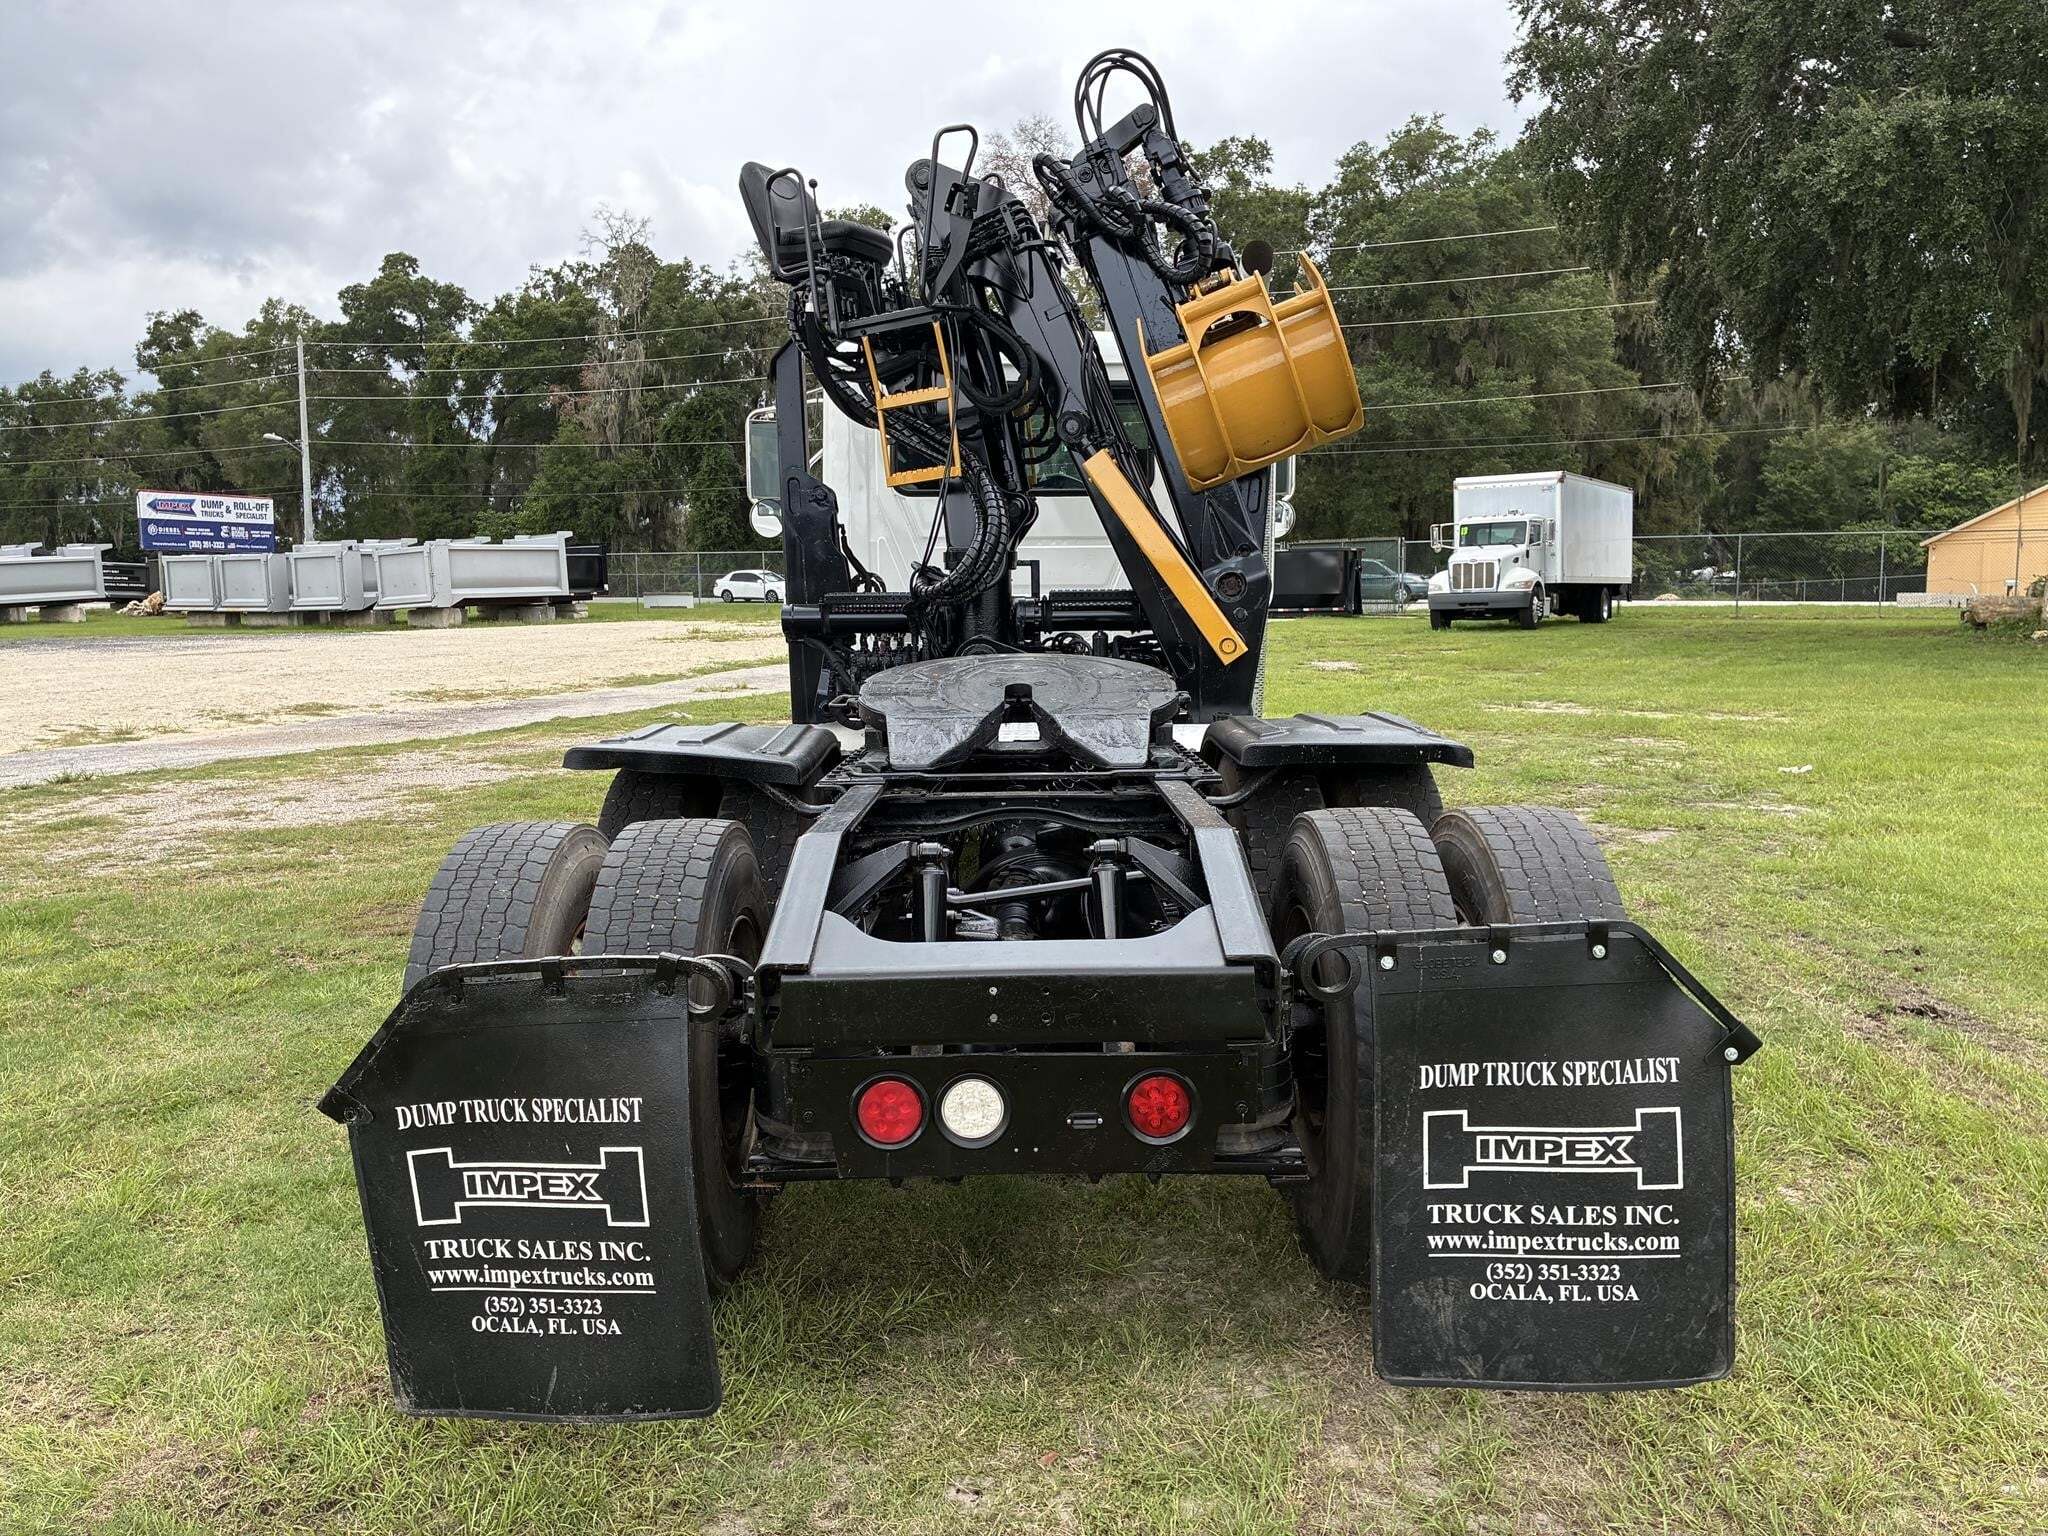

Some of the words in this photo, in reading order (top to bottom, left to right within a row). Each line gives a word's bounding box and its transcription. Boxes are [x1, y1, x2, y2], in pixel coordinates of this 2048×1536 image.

[201, 499, 224, 509] DUMP
[225, 505, 232, 514] &
[233, 501, 270, 512] ROLL-OFF
[201, 510, 224, 519] TRUCKS
[235, 512, 267, 520] SPECIALIST
[1419, 1063, 1479, 1089] DUMP
[1483, 1062, 1558, 1086] TRUCK
[1563, 1057, 1680, 1086] SPECIALIST
[395, 1102, 456, 1130] DUMP
[460, 1098, 529, 1123] TRUCK
[532, 1097, 642, 1123] SPECIALIST
[1476, 1135, 1635, 1164] IMPEX
[463, 1171, 603, 1200] IMPEX
[1427, 1204, 1524, 1224] TRUCK
[1531, 1205, 1617, 1225] SALES
[1624, 1205, 1679, 1225] INC.
[424, 1239, 513, 1259] TRUCK
[518, 1240, 593, 1260] SALES
[598, 1242, 650, 1261] INC.
[1427, 1230, 1680, 1253] www.impextrucks.com
[428, 1264, 654, 1288] www.impextrucks.com
[1487, 1263, 1533, 1283] (352)
[1538, 1264, 1620, 1280] 351-3323
[1470, 1283, 1553, 1304] OCALA,
[1558, 1285, 1591, 1301] FL.
[1597, 1285, 1640, 1301] USA
[485, 1296, 524, 1316] (352)
[529, 1298, 602, 1314] 351-3323
[472, 1316, 543, 1337] OCALA,
[548, 1318, 577, 1334] FL.
[582, 1319, 622, 1335] USA
